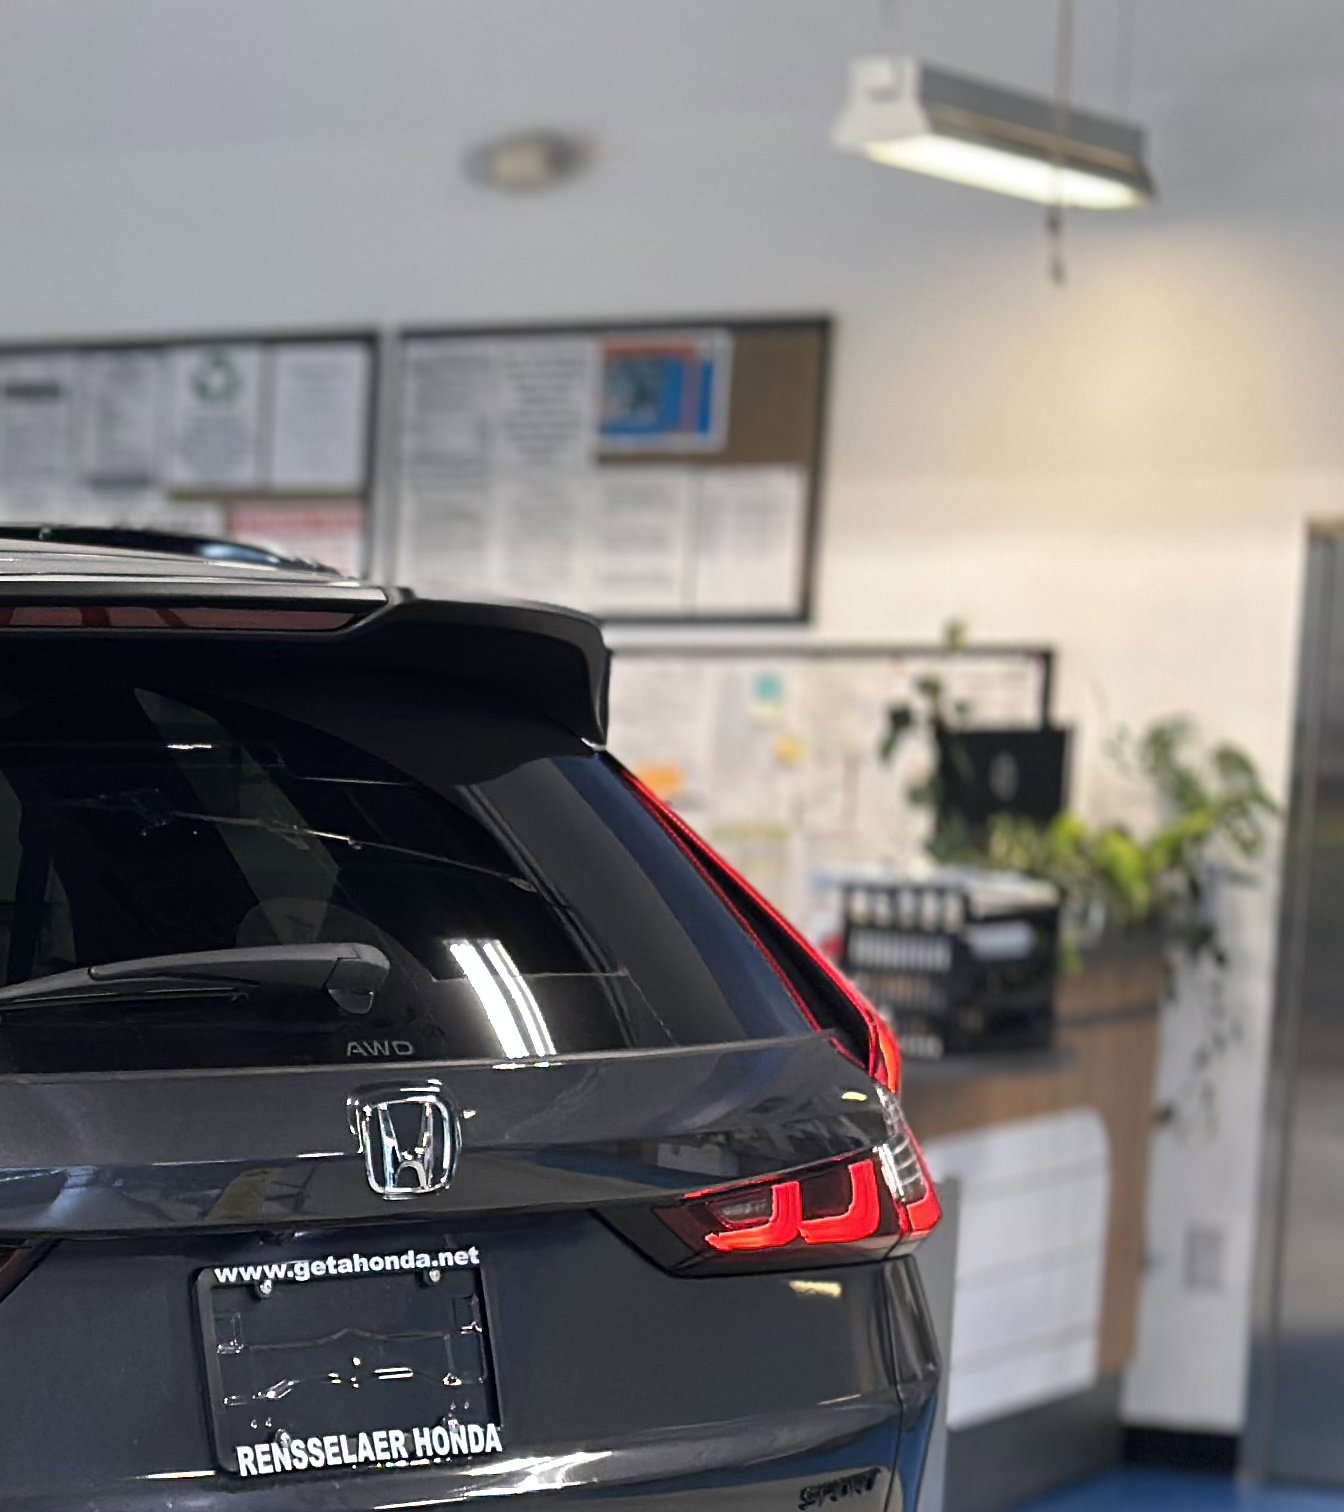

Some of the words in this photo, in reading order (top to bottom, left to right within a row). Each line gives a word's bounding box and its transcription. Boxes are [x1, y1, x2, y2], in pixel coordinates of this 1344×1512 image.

[347, 1040, 414, 1057] AWD
[214, 1246, 480, 1283] www.getahonda.net
[236, 1428, 410, 1477] RENSSELAER
[413, 1423, 503, 1458] HONDA
